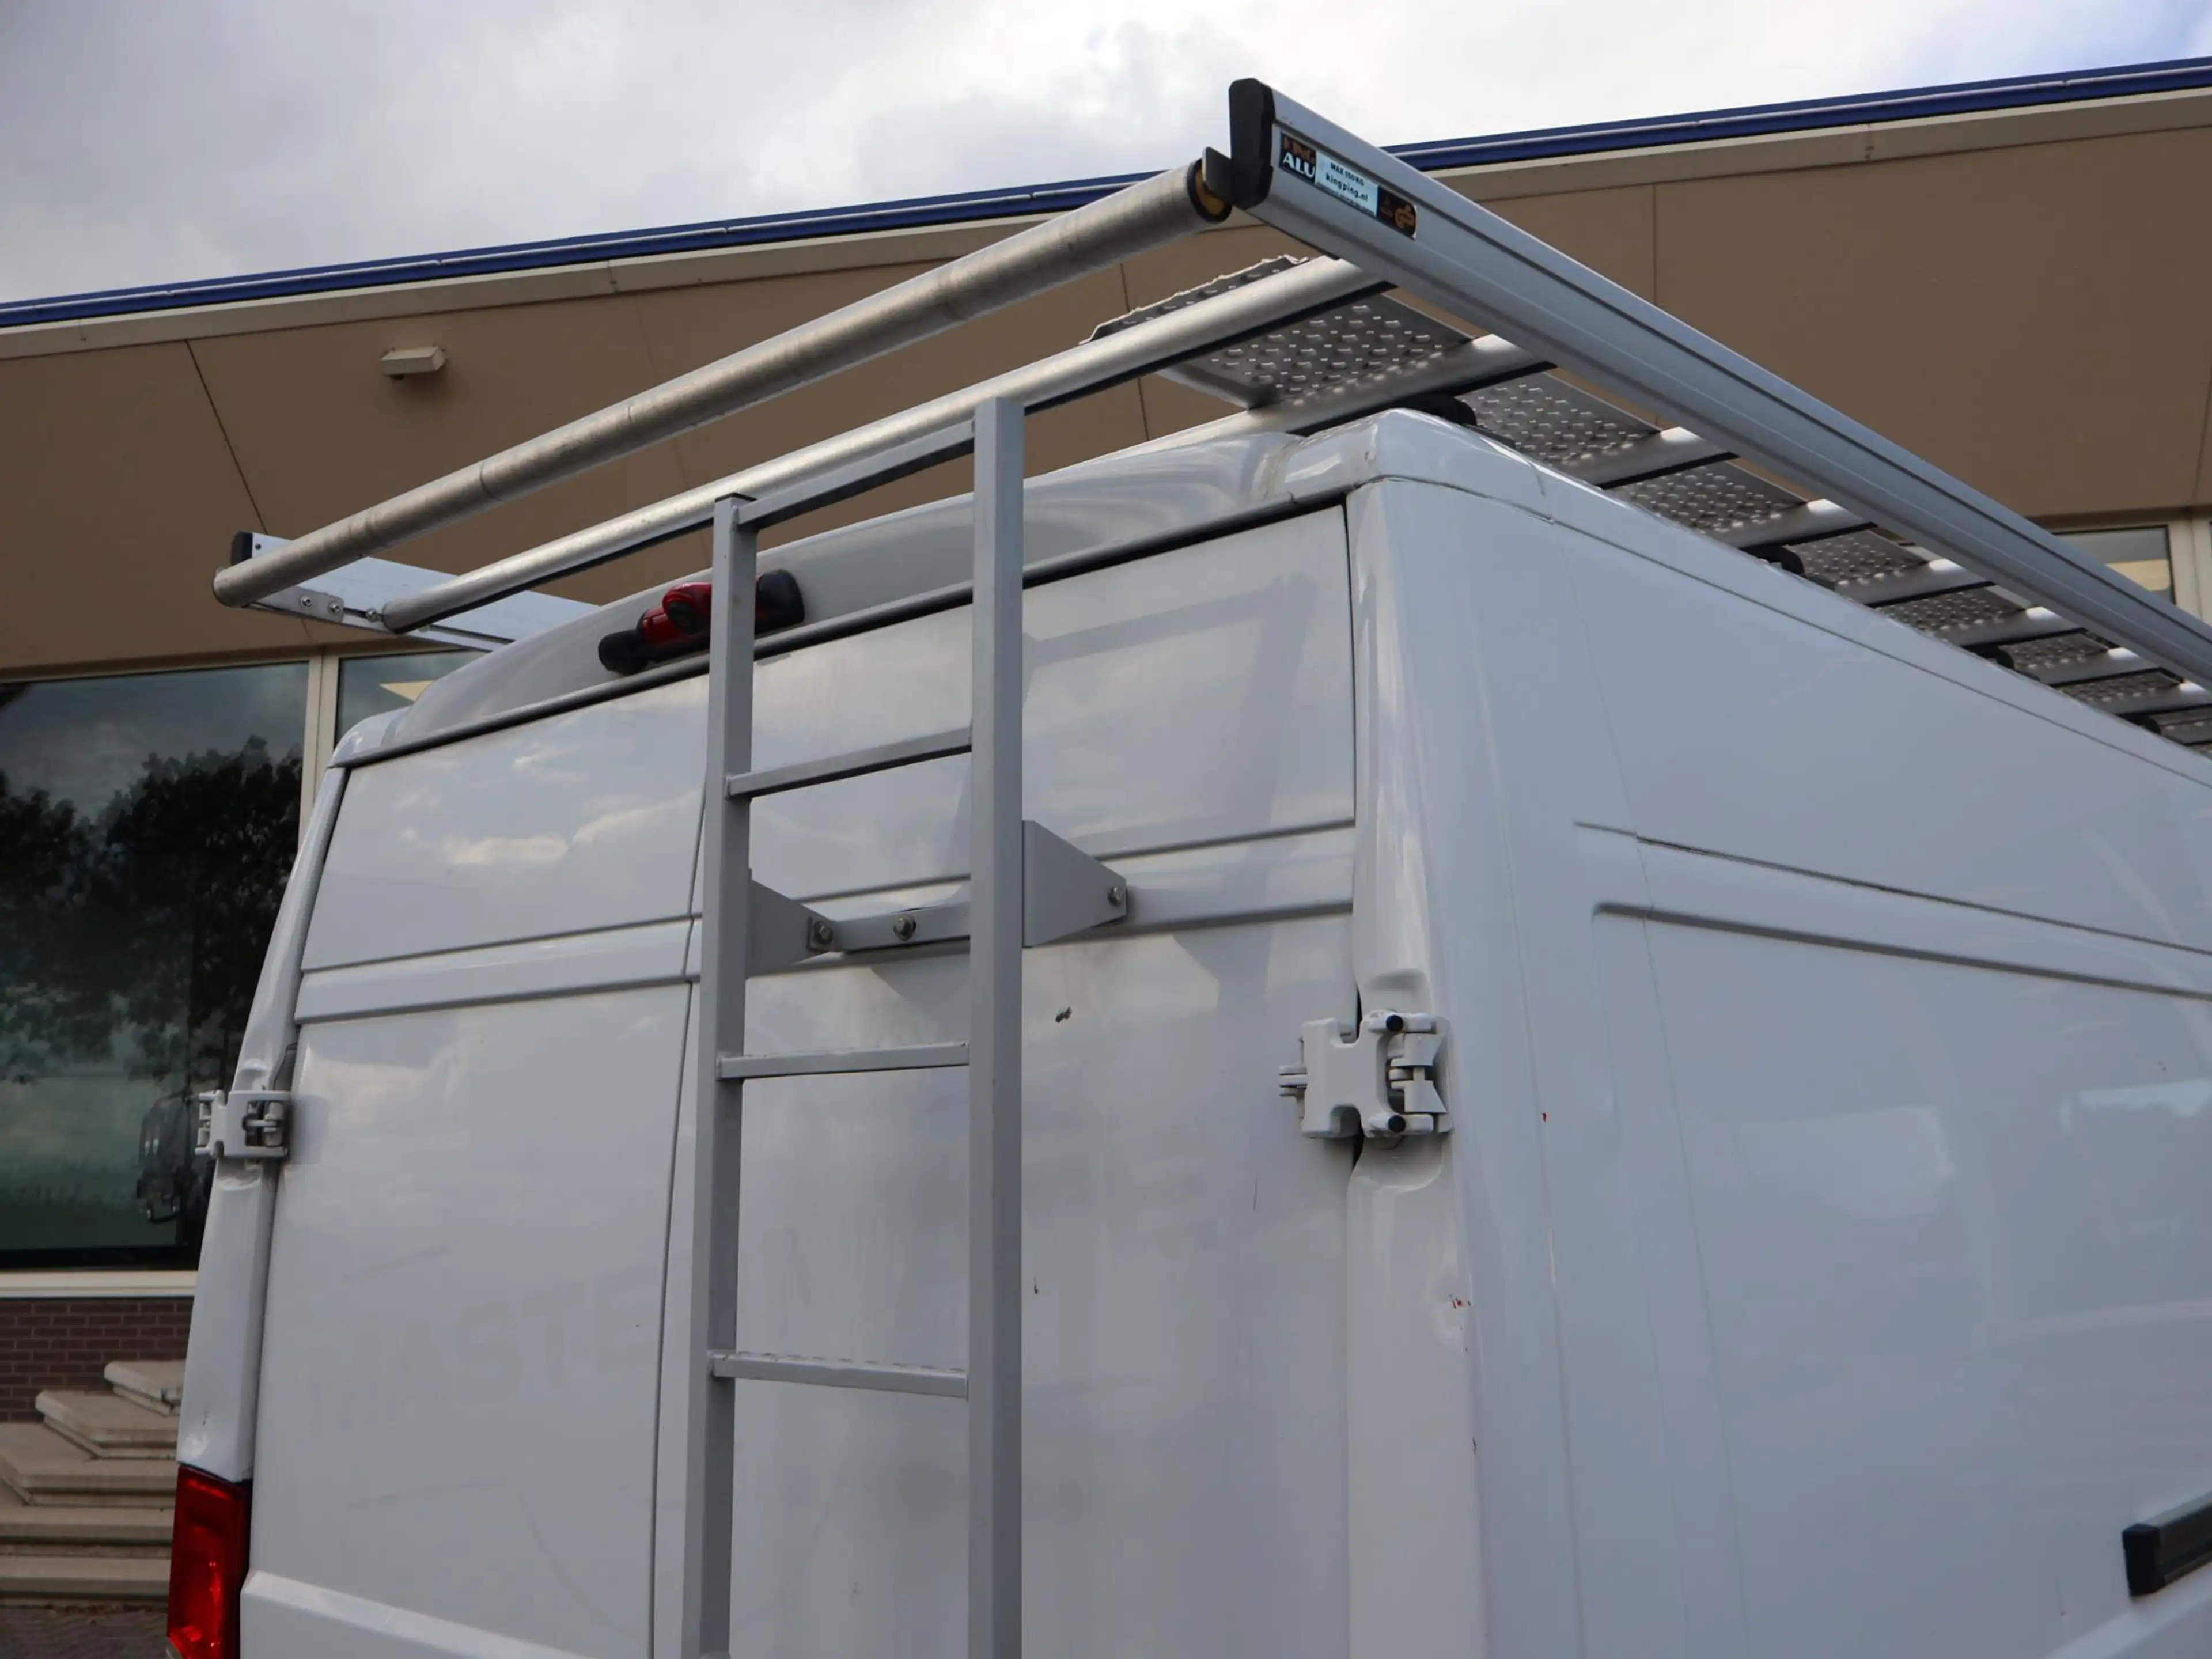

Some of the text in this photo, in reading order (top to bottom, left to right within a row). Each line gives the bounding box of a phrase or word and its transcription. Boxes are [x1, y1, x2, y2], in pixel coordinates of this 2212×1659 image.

[1282, 151, 1316, 179] ALU
[1330, 162, 1344, 176] MAX
[1325, 172, 1369, 201] kingping.nl
